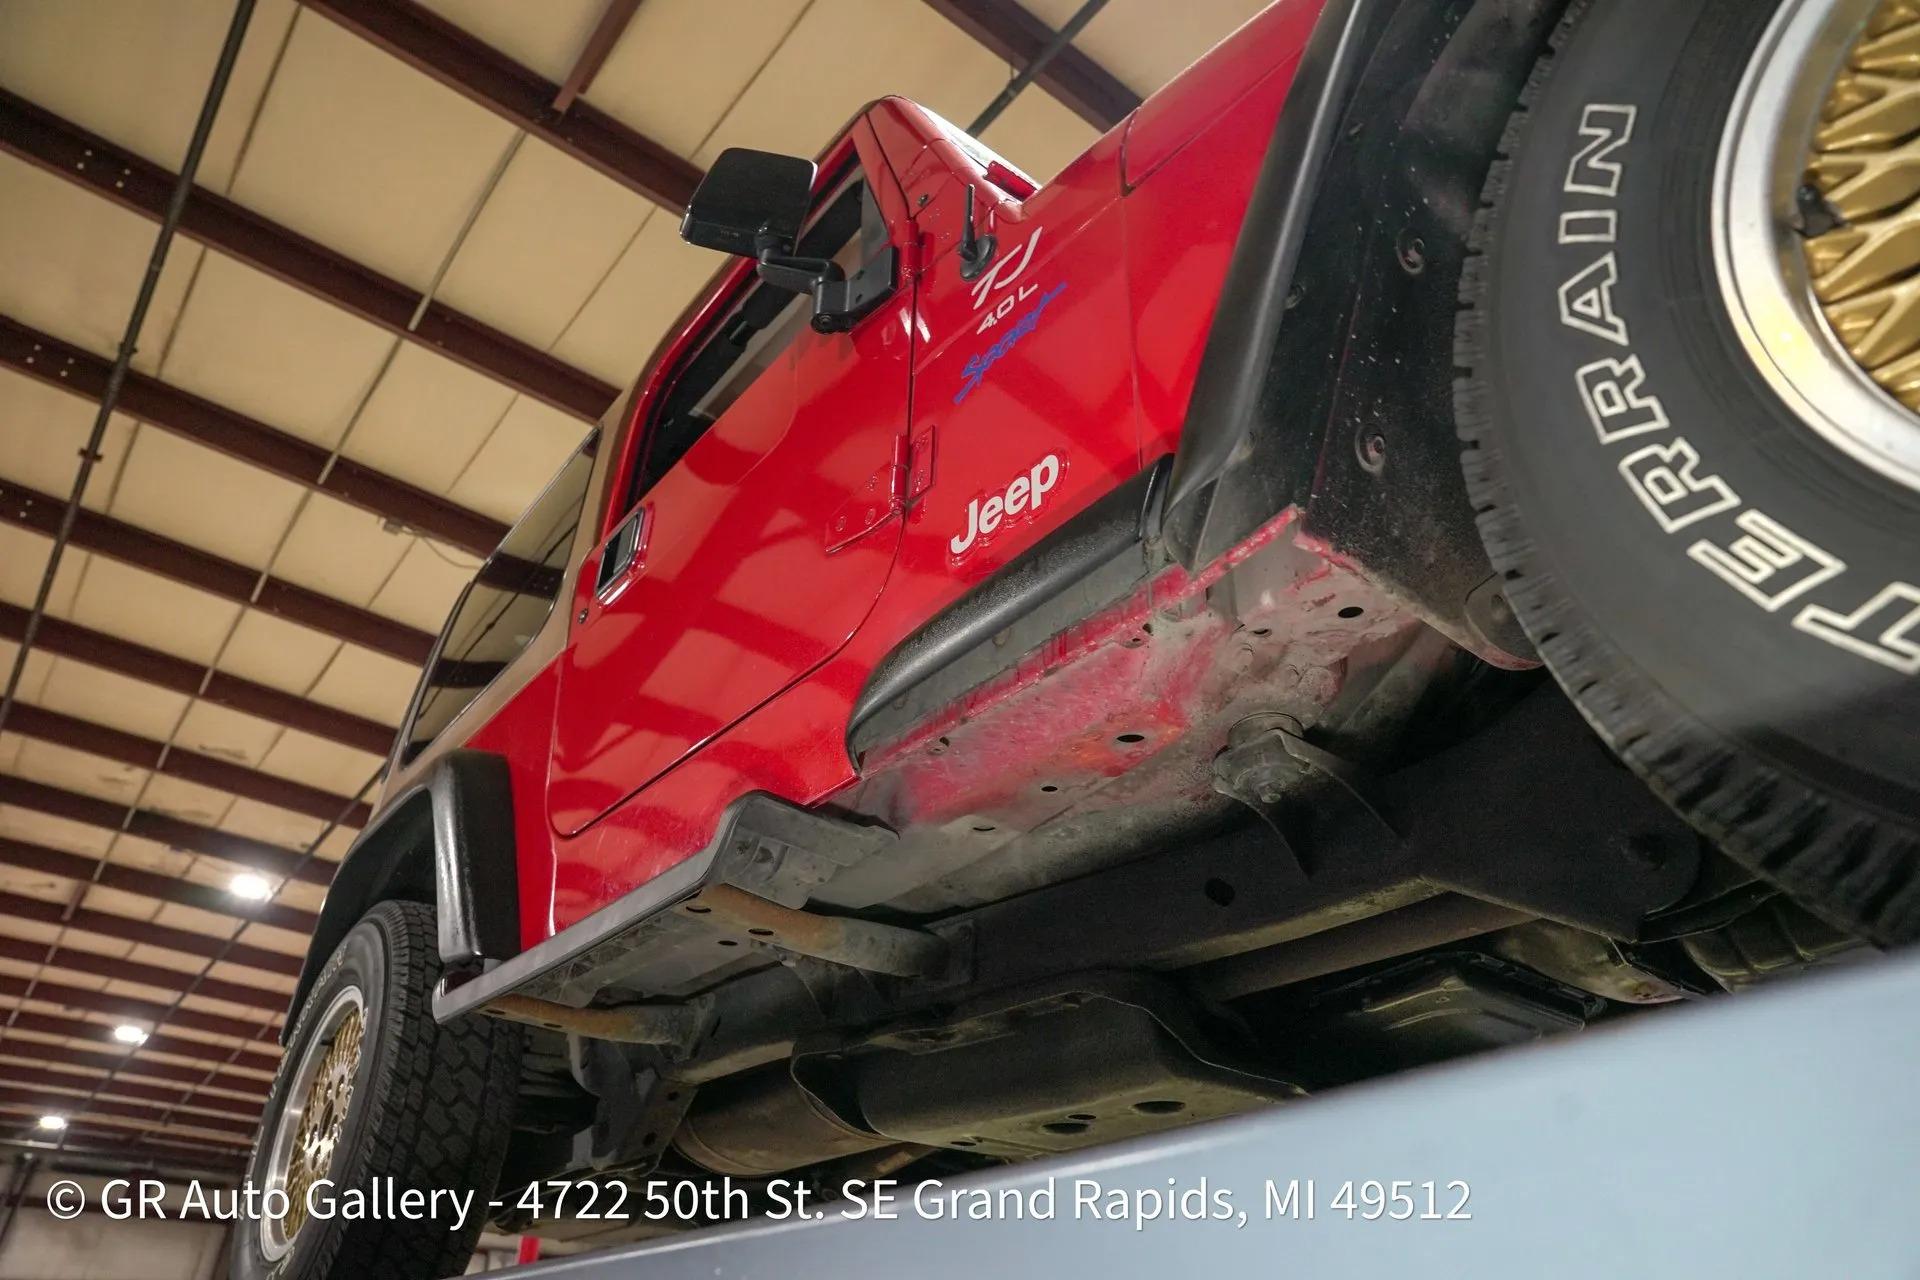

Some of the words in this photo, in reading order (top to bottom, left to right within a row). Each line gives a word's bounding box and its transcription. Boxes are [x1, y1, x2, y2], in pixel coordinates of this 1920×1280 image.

[971, 226, 1043, 310] TJ
[953, 282, 1068, 405] Sport
[1558, 103, 1920, 674] TERRAIN
[950, 454, 1060, 555] Jeep
